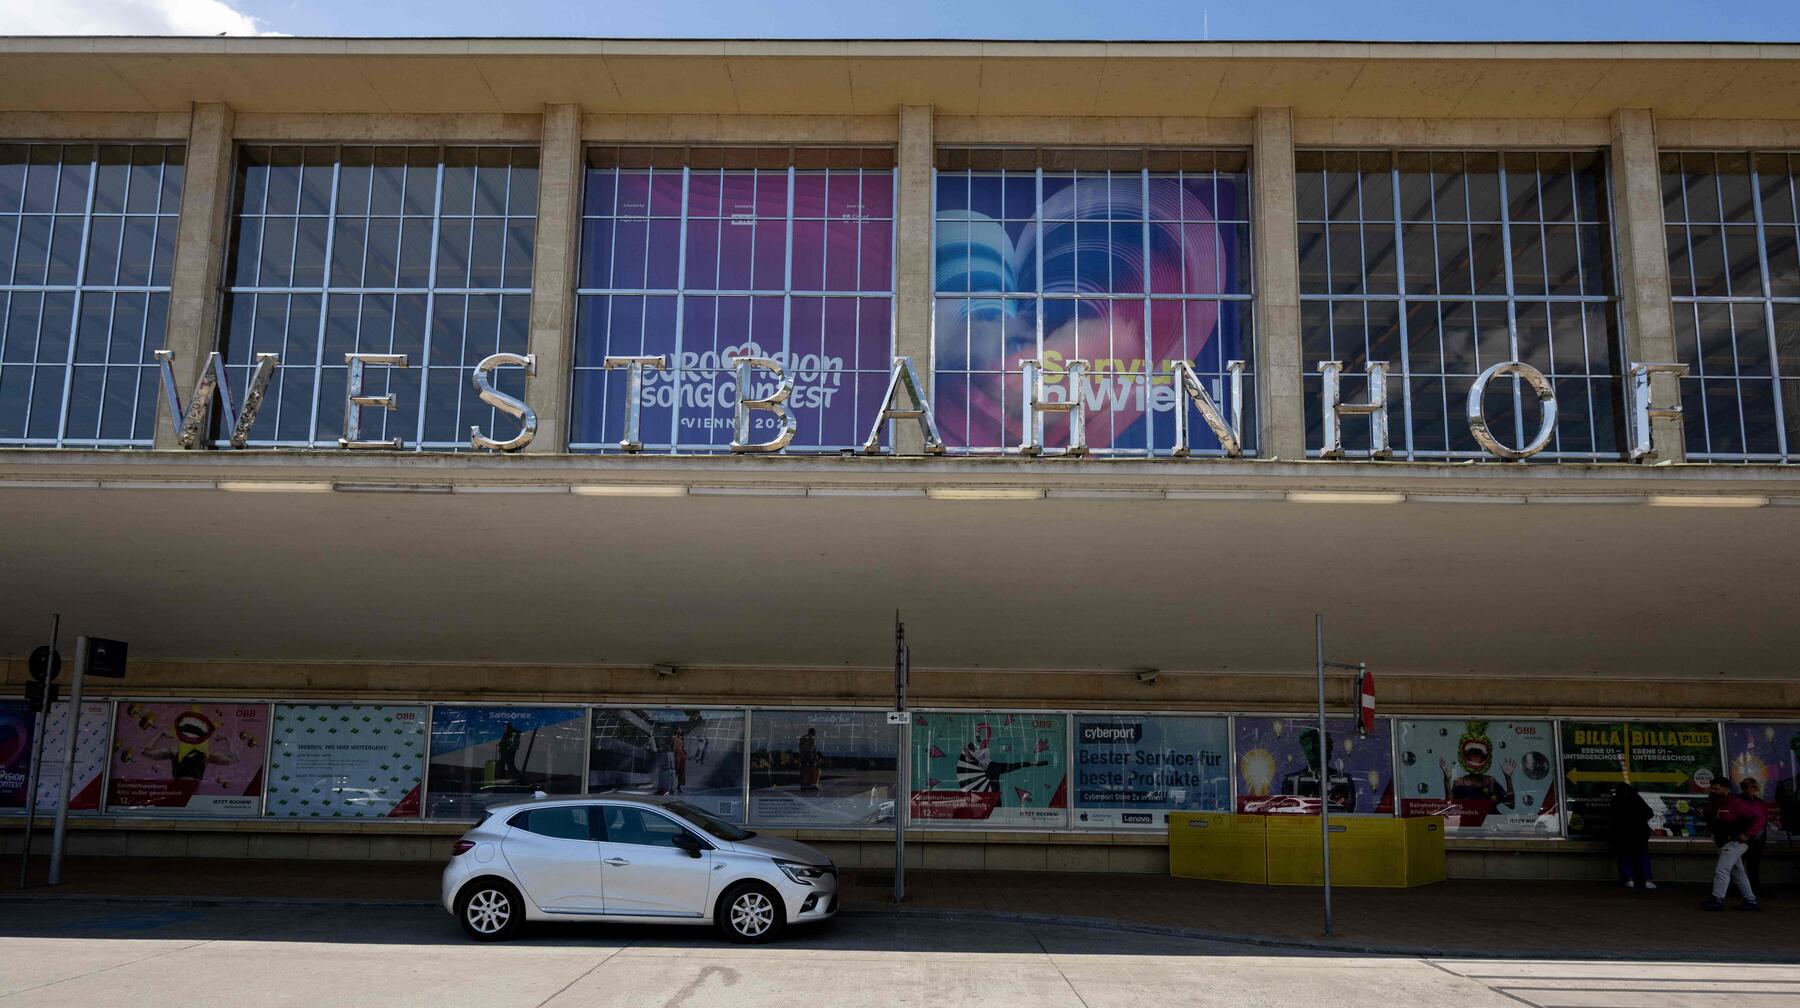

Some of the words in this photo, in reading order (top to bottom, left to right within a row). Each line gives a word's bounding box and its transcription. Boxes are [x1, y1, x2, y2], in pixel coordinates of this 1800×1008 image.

[1042, 350, 1196, 385] Srvu
[153, 349, 1690, 464] WESTBAHNHOF
[681, 417, 741, 429] VIENN
[755, 417, 787, 430] 202
[1085, 726, 1135, 739] cyberport
[1574, 730, 1620, 745] BILLA
[1631, 730, 1679, 746] BILLA
[1682, 734, 1710, 744] PLUS
[1079, 749, 1130, 765] Bester
[1135, 750, 1194, 766] Service
[1200, 751, 1222, 767] für
[1632, 754, 1696, 762] UNTERGESCHOSS
[1079, 769, 1122, 785] beste
[1128, 771, 1199, 787] Produkte
[1084, 792, 1114, 801] Cyberport
[1124, 814, 1151, 822] Lenovo
